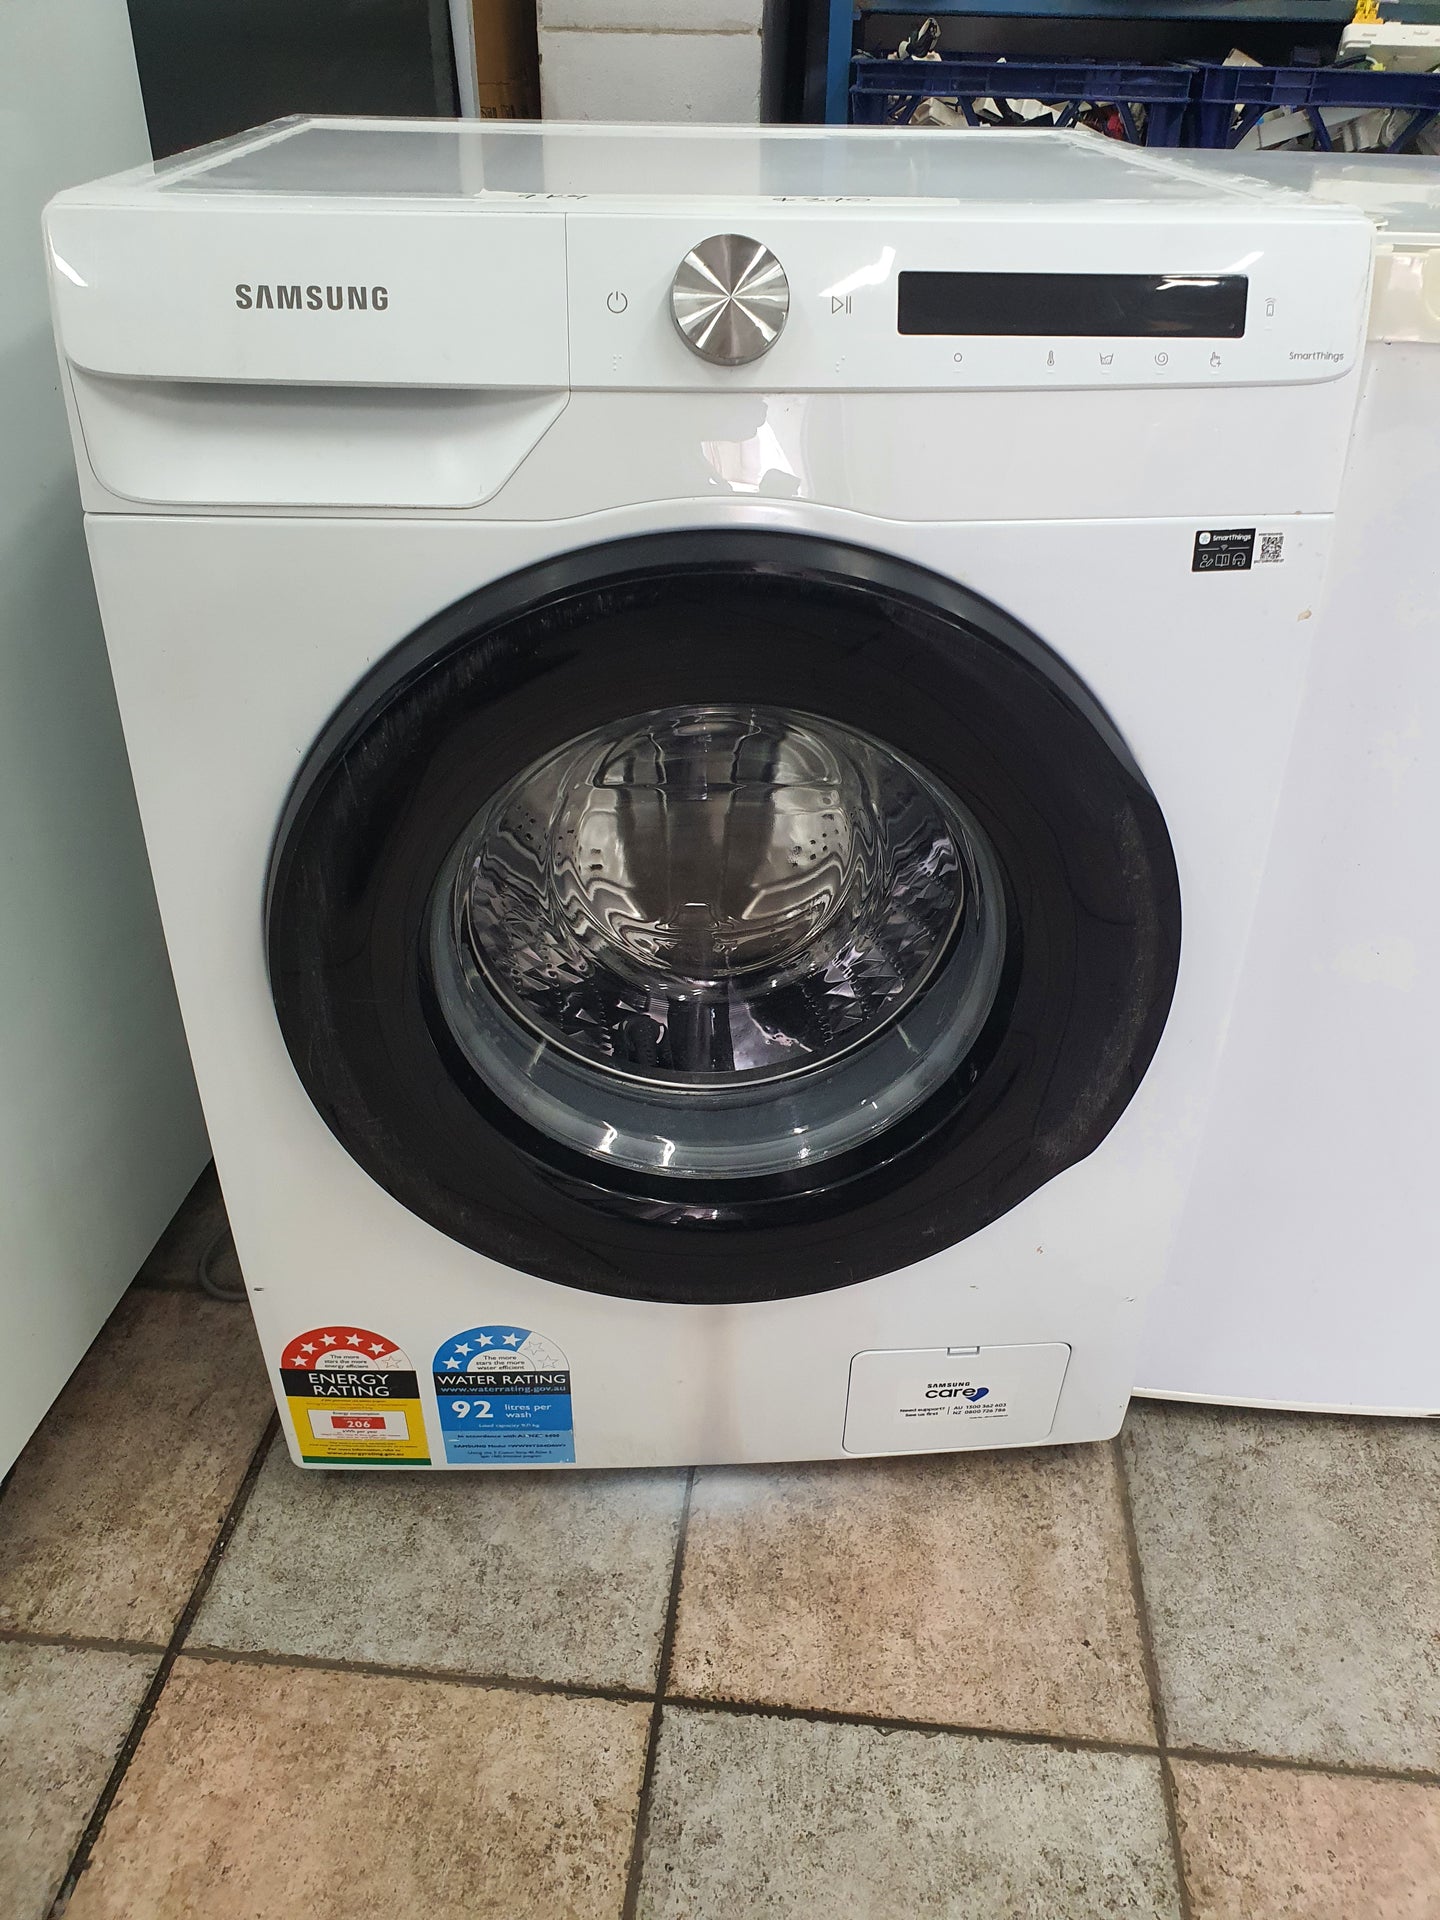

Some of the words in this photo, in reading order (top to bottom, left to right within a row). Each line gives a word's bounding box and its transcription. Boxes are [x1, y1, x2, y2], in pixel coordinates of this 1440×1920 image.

[235, 284, 389, 311] SAMSUNG
[1289, 351, 1344, 363] SmartThings
[1212, 533, 1251, 542] SmartThings
[308, 1373, 389, 1385] ENERGY
[437, 1375, 497, 1385] WATER
[502, 1374, 566, 1384] RATING
[440, 1385, 566, 1393] www.waterrating.gov.au
[927, 1381, 971, 1389] SAMSUNG
[313, 1385, 390, 1397] RATING
[925, 1387, 976, 1399] care
[451, 1400, 494, 1419] 92
[504, 1403, 530, 1411] litres
[534, 1404, 552, 1412] per
[346, 1420, 370, 1428] 206
